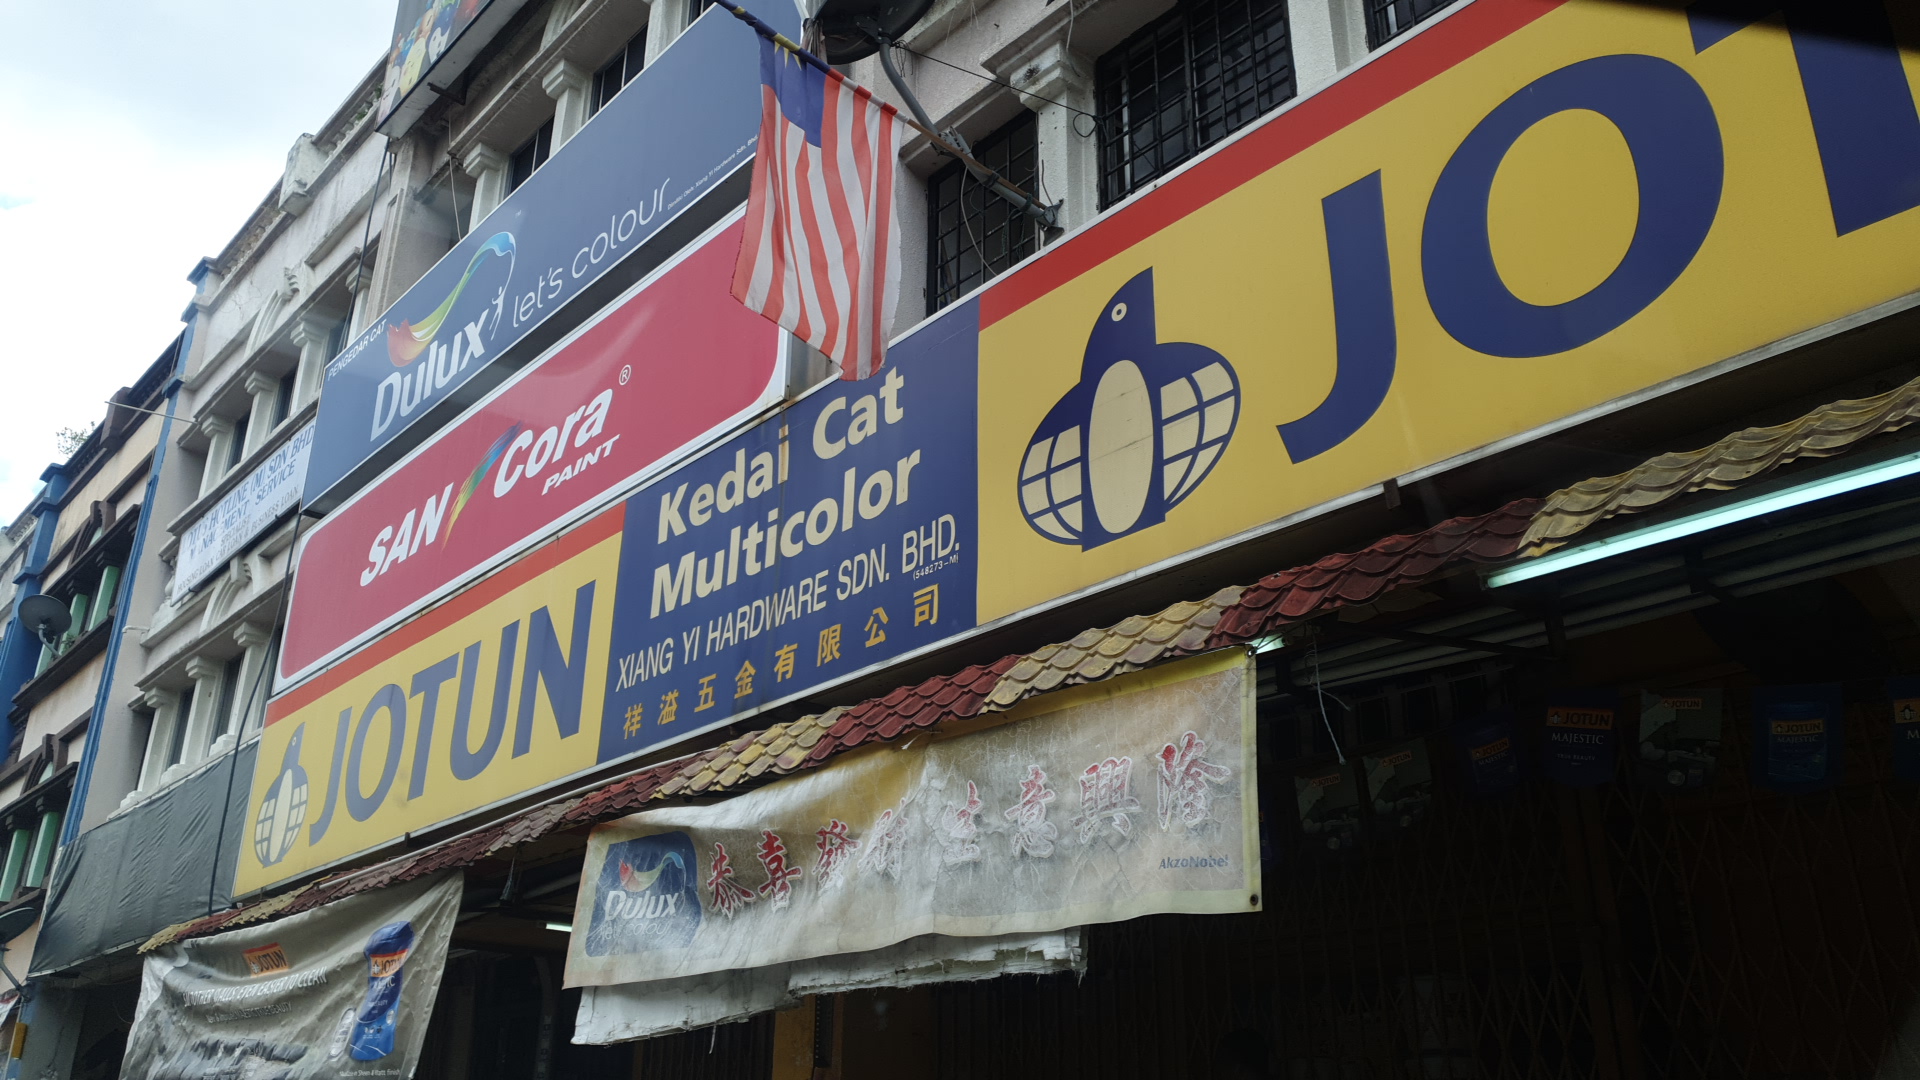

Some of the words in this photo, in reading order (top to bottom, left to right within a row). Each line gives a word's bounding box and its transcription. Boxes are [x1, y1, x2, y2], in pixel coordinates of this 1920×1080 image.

[512, 267, 563, 328] let's
[571, 177, 671, 279] colour
[327, 335, 370, 382] PENGEDAR
[369, 318, 387, 342] CAT
[370, 308, 490, 442] Dulux
[541, 434, 620, 495] PAINT
[657, 424, 789, 545] Kedai
[812, 366, 905, 460] Cat
[255, 459, 296, 506] SERVICE
[360, 483, 454, 587] SAN
[494, 389, 613, 498] Cora
[650, 449, 921, 619] Multicolor
[615, 637, 674, 692] XIANG
[682, 625, 700, 665] YI
[705, 569, 828, 656] HARDWARE
[836, 543, 890, 601] SDN.
[902, 513, 960, 574] BHD.
[309, 579, 596, 847] JOTUN
[1562, 712, 1611, 727] JOTUN
[1671, 699, 1700, 708] JOTUN
[1551, 732, 1605, 745] MAJESTIC
[1785, 723, 1821, 733] JOTUN
[1388, 752, 1411, 766] JOTUN
[1482, 739, 1509, 757] JOTUN
[1316, 774, 1340, 787] JOTUN
[1158, 854, 1229, 870] AkzoNobel
[604, 890, 680, 921] Dulux
[258, 949, 287, 974] JOTUN
